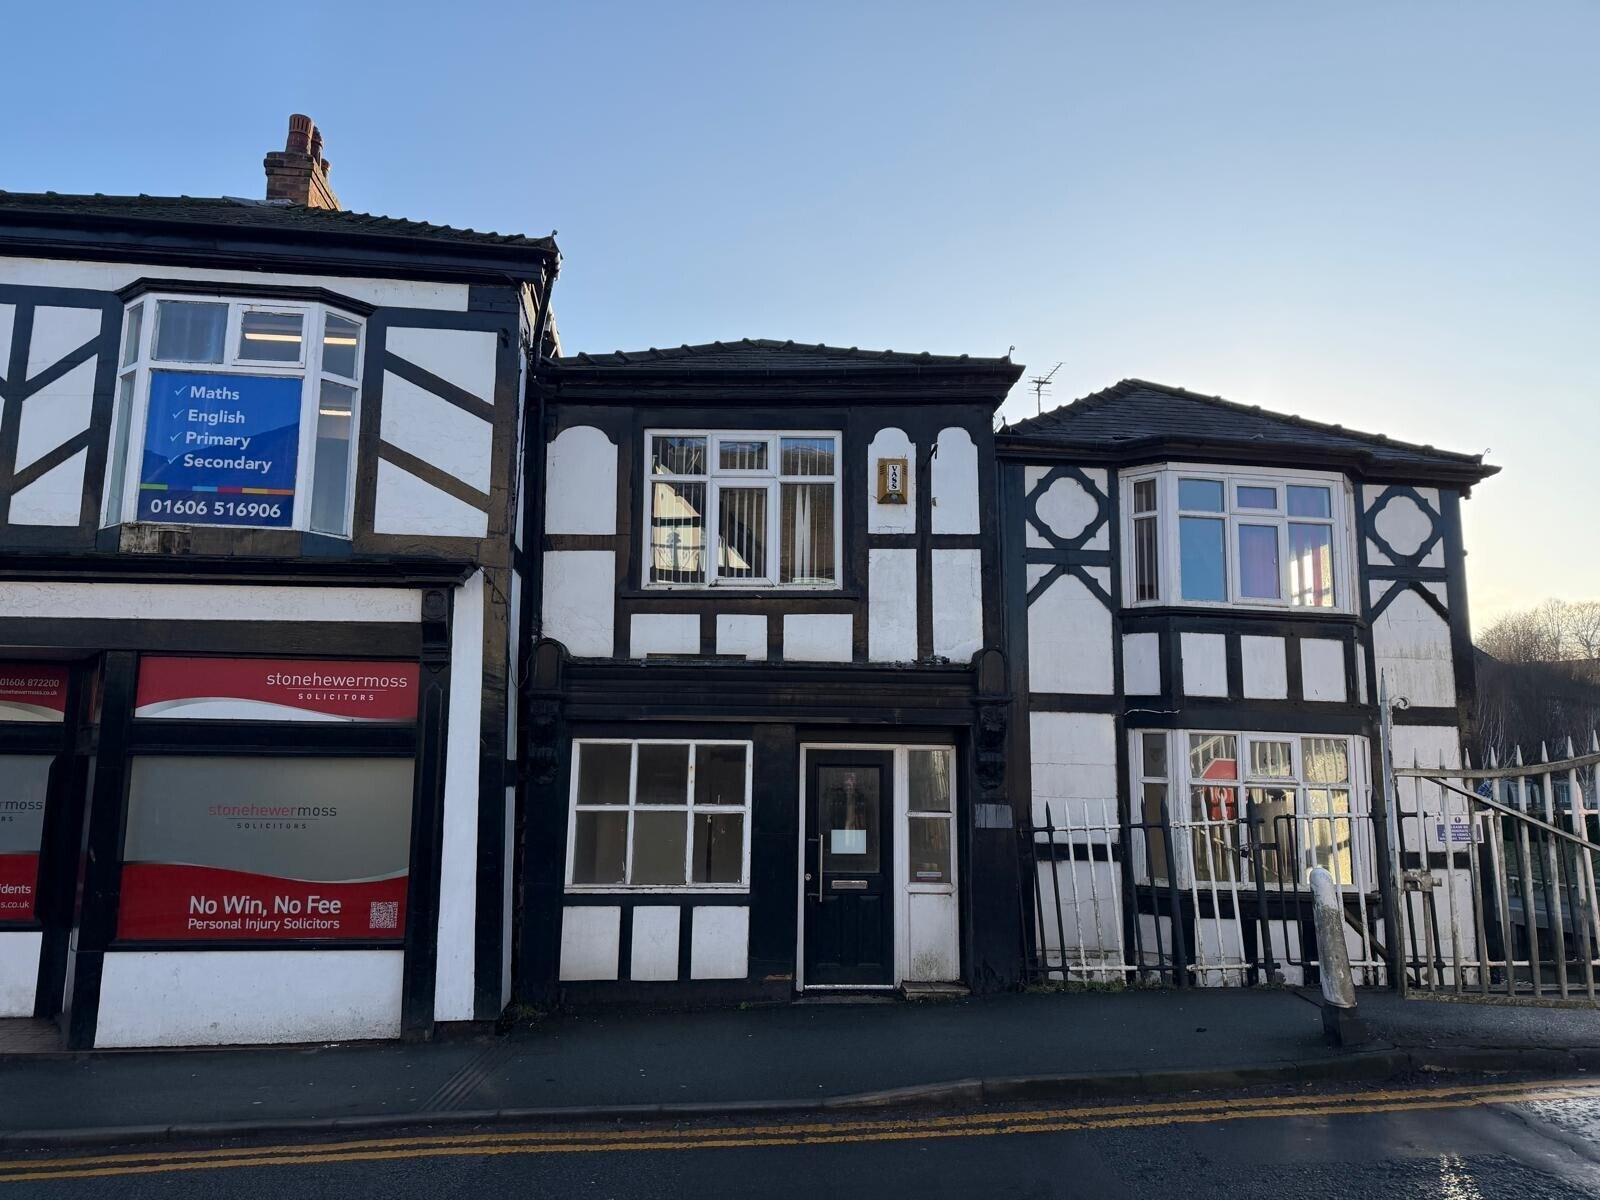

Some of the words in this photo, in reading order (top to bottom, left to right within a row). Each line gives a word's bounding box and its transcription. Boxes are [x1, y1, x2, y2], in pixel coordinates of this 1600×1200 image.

[190, 385, 240, 400] Maths
[188, 409, 245, 425] English
[185, 431, 251, 449] Primary
[183, 454, 272, 474] Secondary
[150, 499, 208, 516] 01606
[213, 501, 281, 518] 516906
[0, 678, 25, 686] 01606
[27, 679, 60, 688] 872200
[266, 672, 408, 688] stonehewermoss
[298, 693, 374, 701] SOLICITORS
[208, 803, 337, 817] stonehewermoss
[189, 895, 217, 914] No
[223, 895, 268, 917] Win,
[274, 895, 302, 914] No
[307, 895, 342, 914] Fee
[188, 918, 242, 930] Personal
[245, 918, 281, 932] Injury
[283, 918, 340, 930] Solicitors
